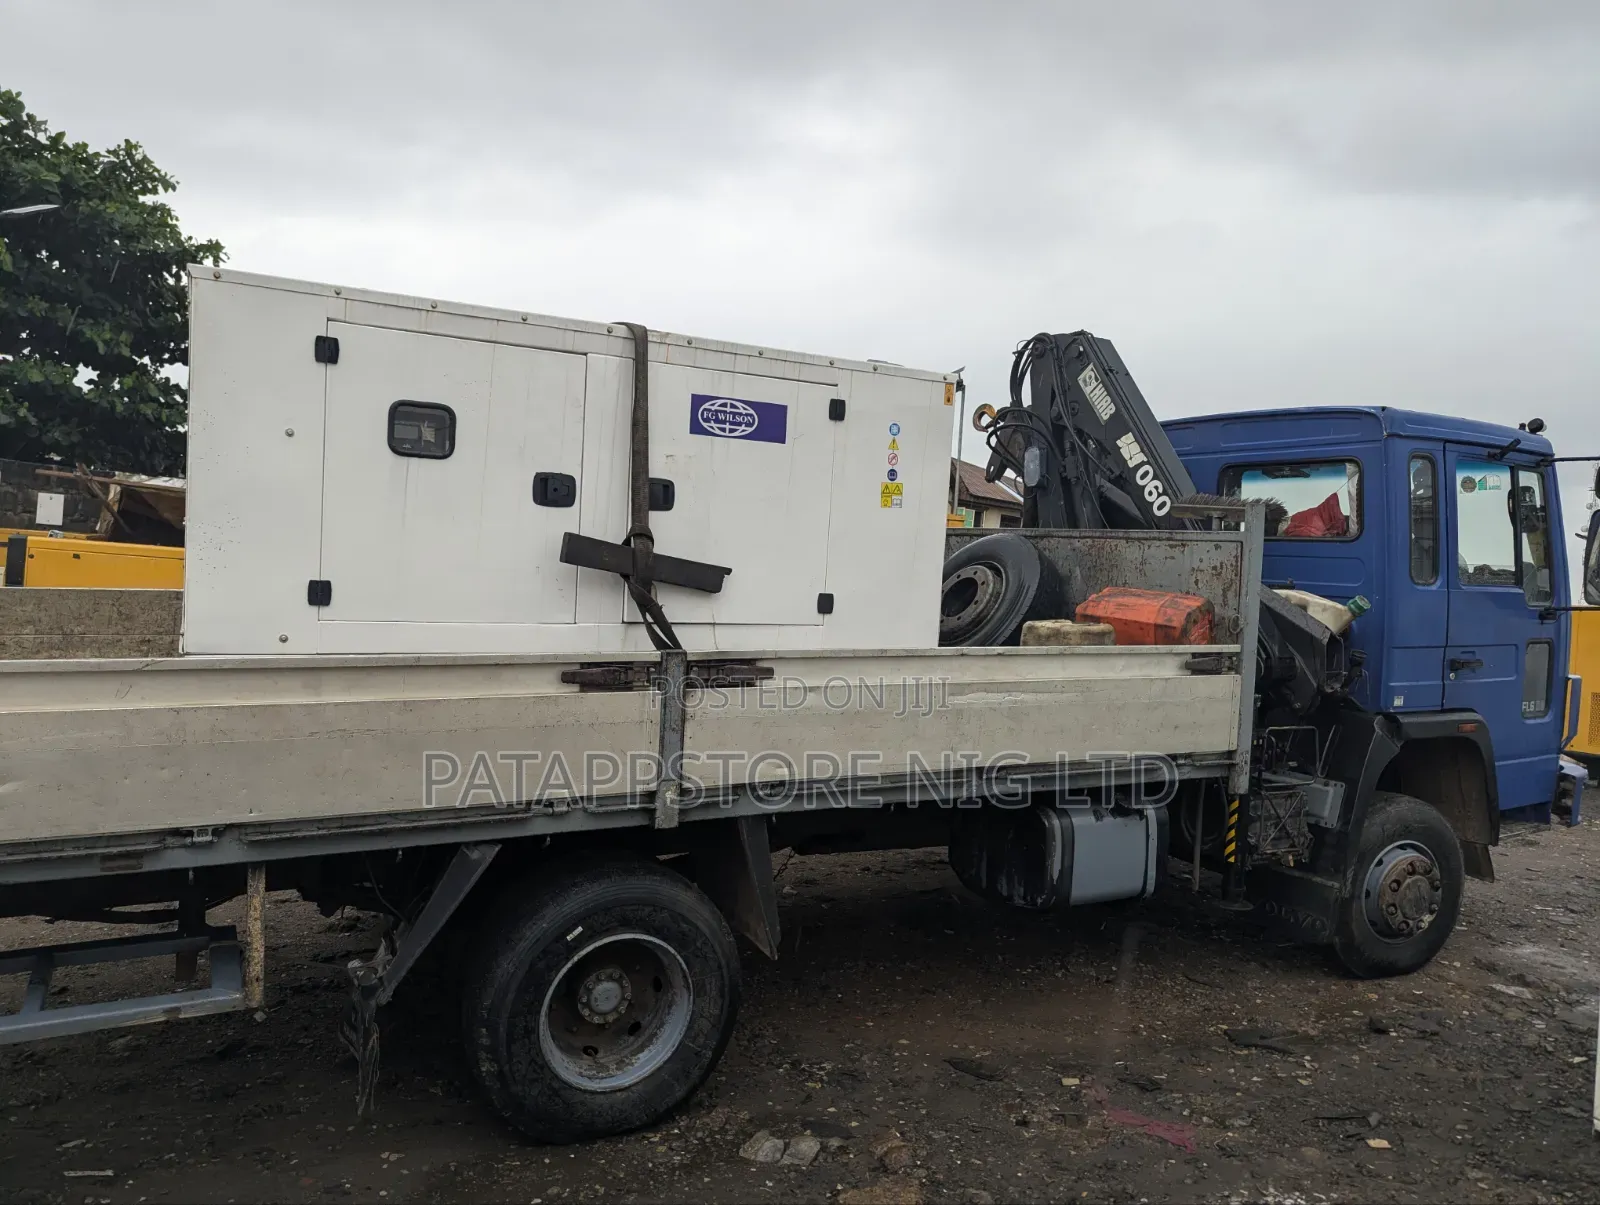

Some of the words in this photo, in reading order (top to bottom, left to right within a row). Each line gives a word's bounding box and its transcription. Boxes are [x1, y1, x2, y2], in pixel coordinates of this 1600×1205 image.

[703, 411, 716, 420] FG
[718, 412, 753, 423] WILSON
[1090, 383, 1116, 420] HIAB
[1135, 464, 1171, 517] 060
